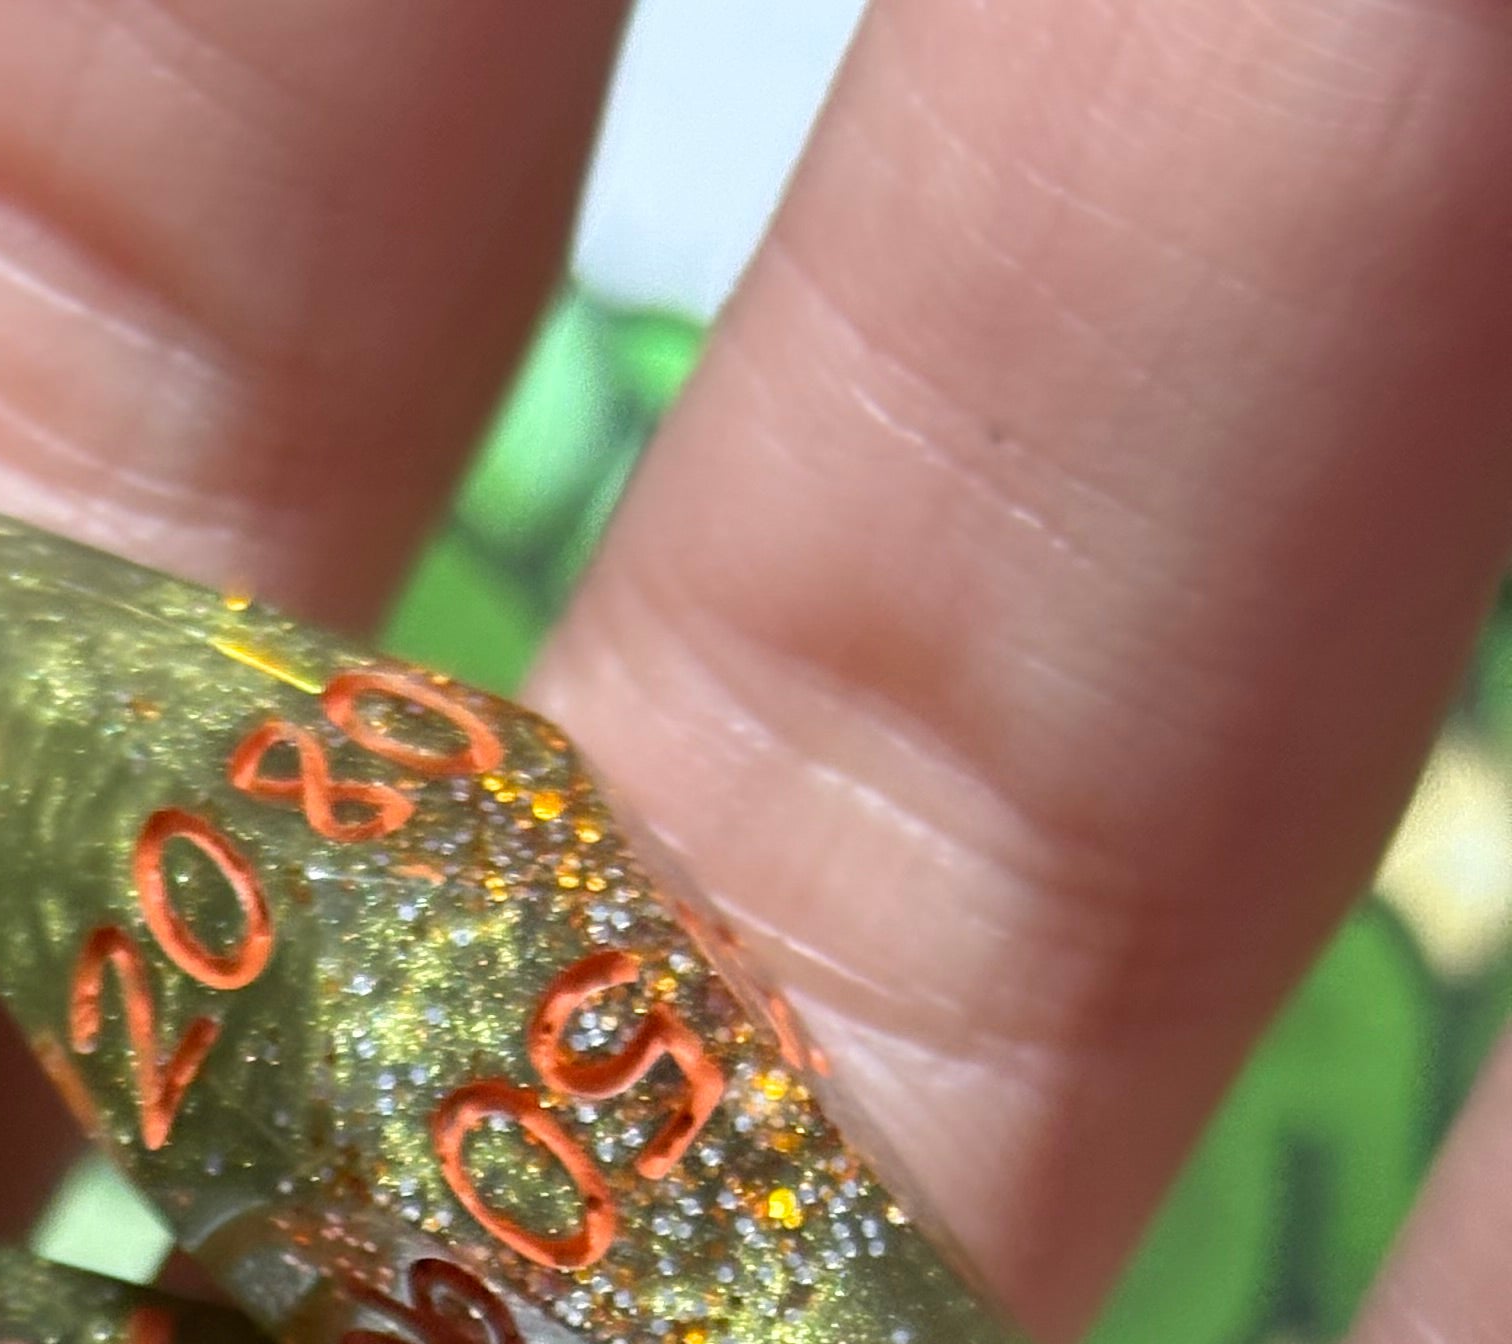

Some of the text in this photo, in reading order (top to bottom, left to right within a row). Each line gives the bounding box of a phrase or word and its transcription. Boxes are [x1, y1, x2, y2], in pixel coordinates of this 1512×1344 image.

[228, 667, 504, 841] 80
[70, 808, 273, 1151] 20
[431, 949, 725, 1270] 50
